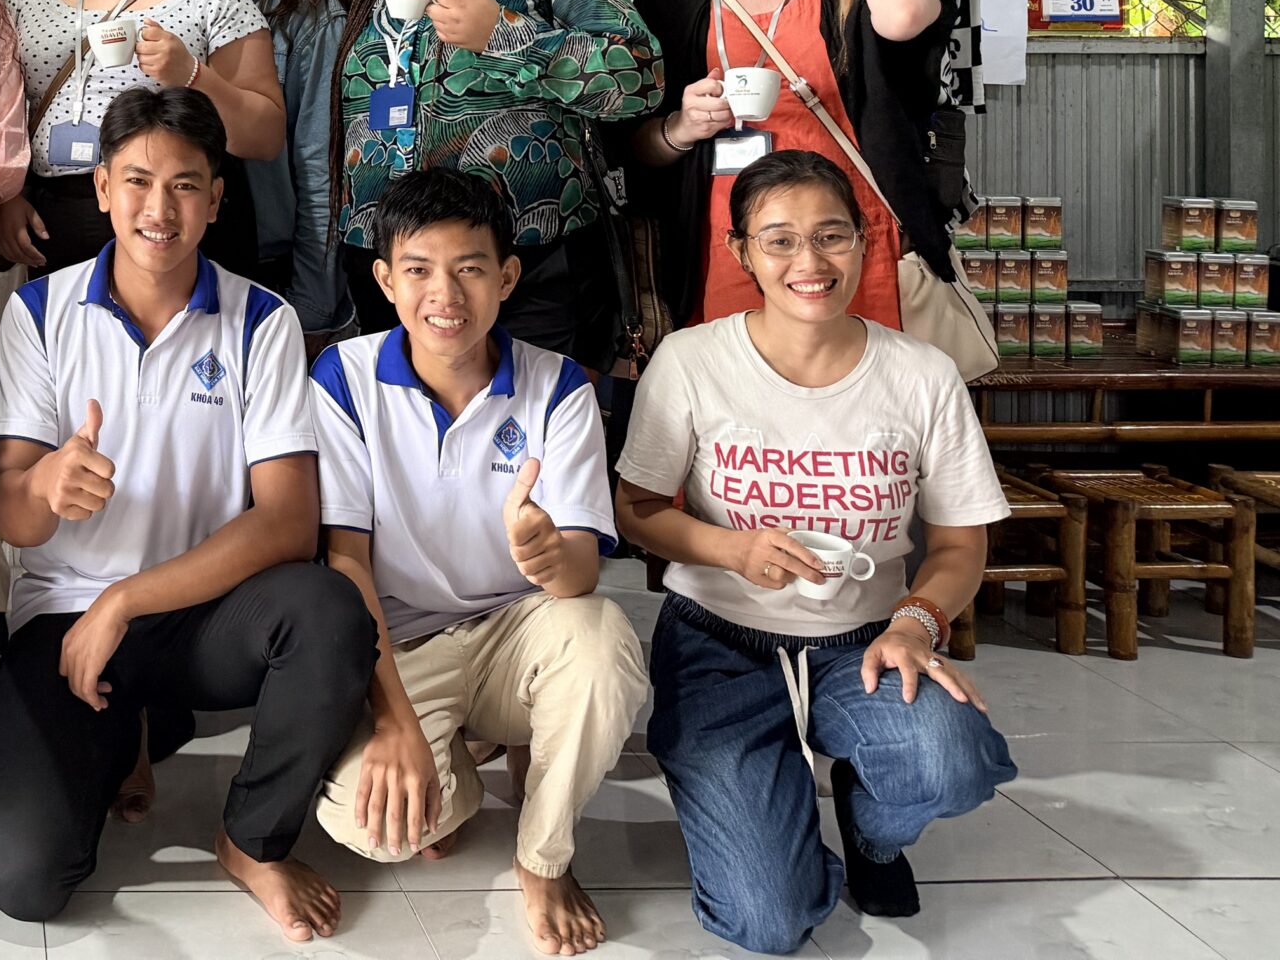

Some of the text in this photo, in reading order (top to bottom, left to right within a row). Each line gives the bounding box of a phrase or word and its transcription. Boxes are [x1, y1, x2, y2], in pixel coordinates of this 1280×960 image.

[190, 392, 224, 406] KHÓA 49
[491, 461, 515, 474] KHÓA
[714, 442, 910, 477] MARKETING
[710, 469, 912, 511] LEADERSHIP
